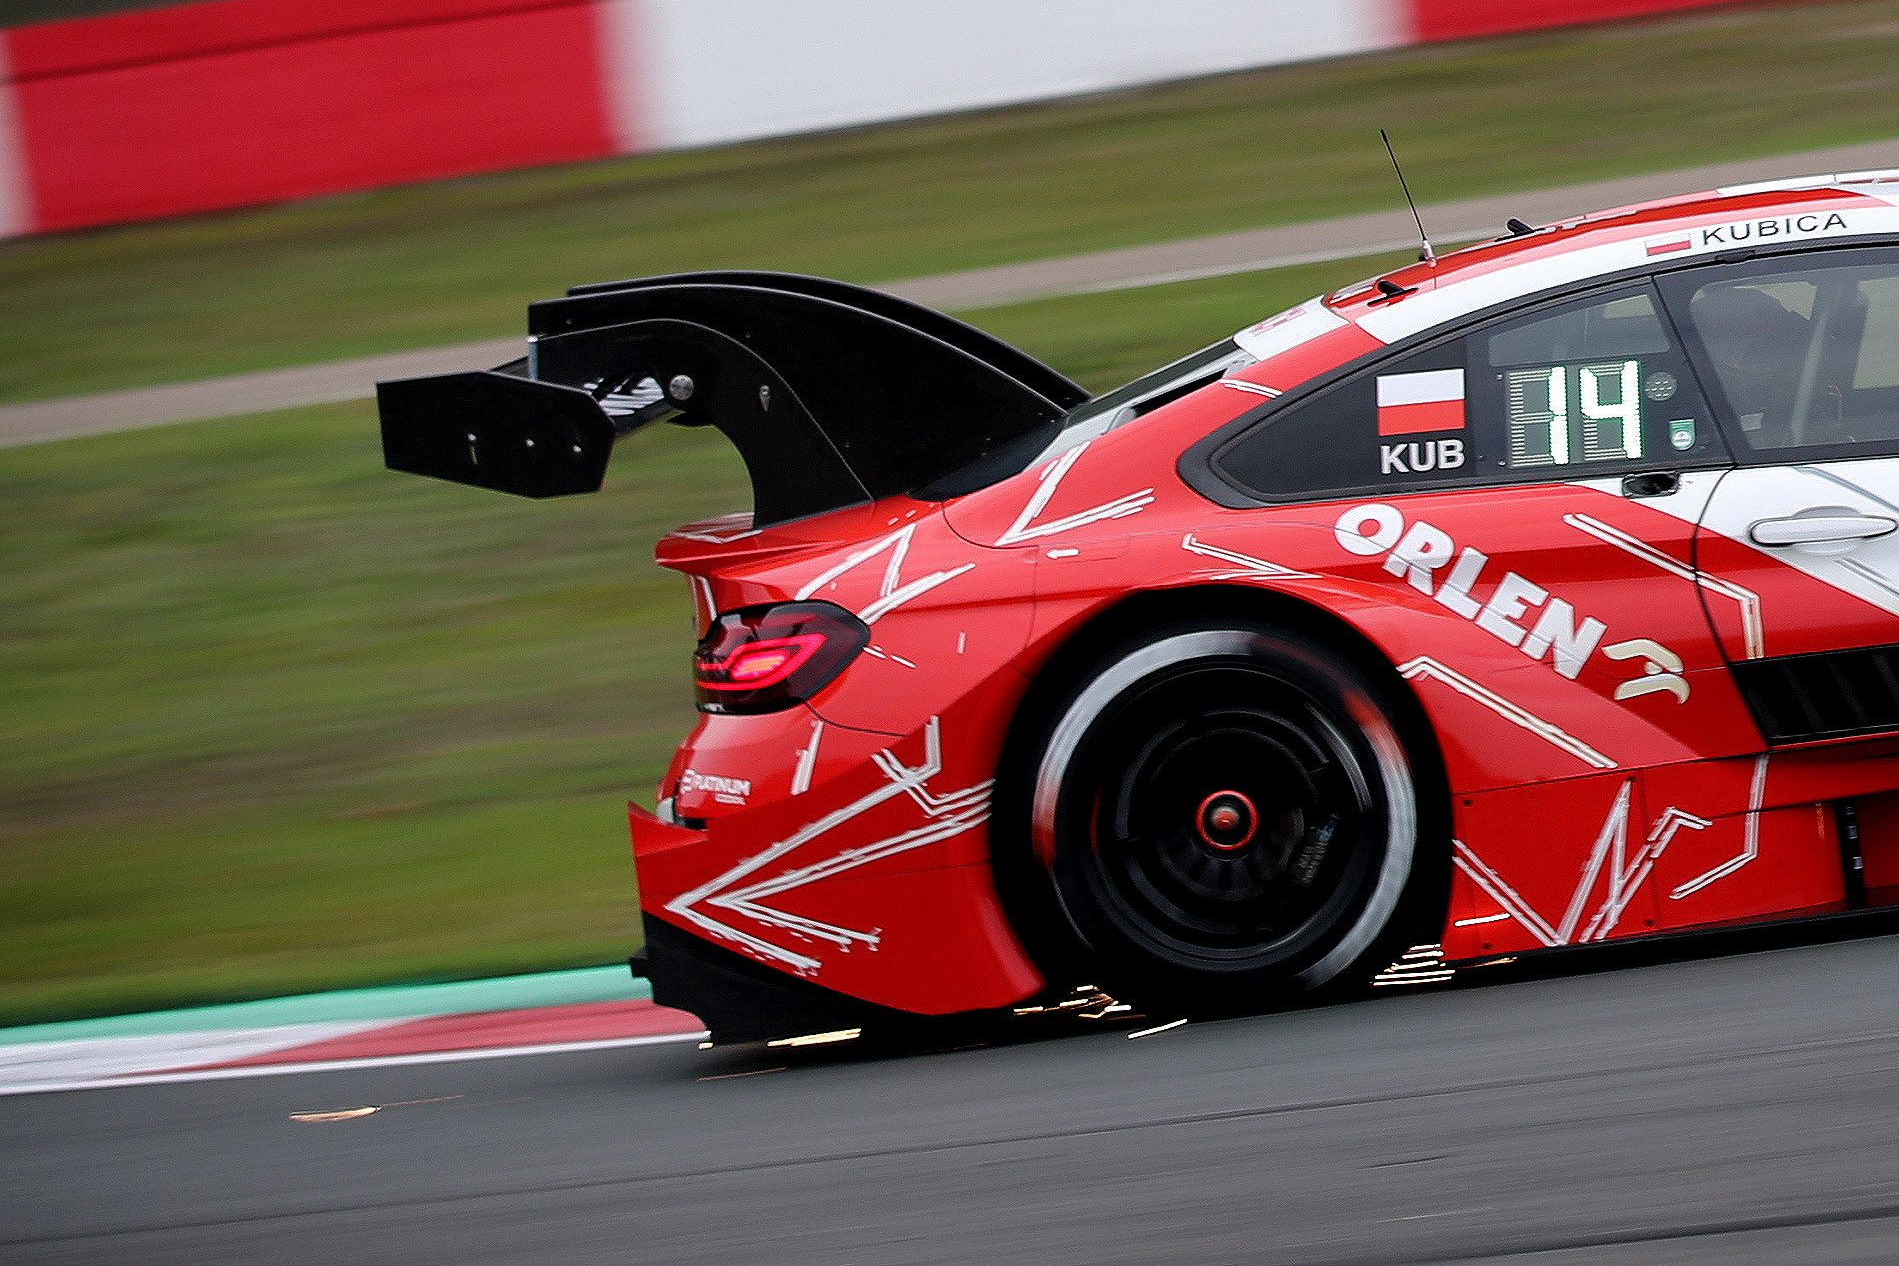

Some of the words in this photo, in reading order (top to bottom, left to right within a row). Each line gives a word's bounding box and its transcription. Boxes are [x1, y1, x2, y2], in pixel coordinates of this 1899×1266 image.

[1701, 211, 1849, 246] KUBICA
[1547, 358, 1642, 466] 14
[1379, 438, 1466, 475] KUB
[1333, 502, 1609, 683] ORLEN
